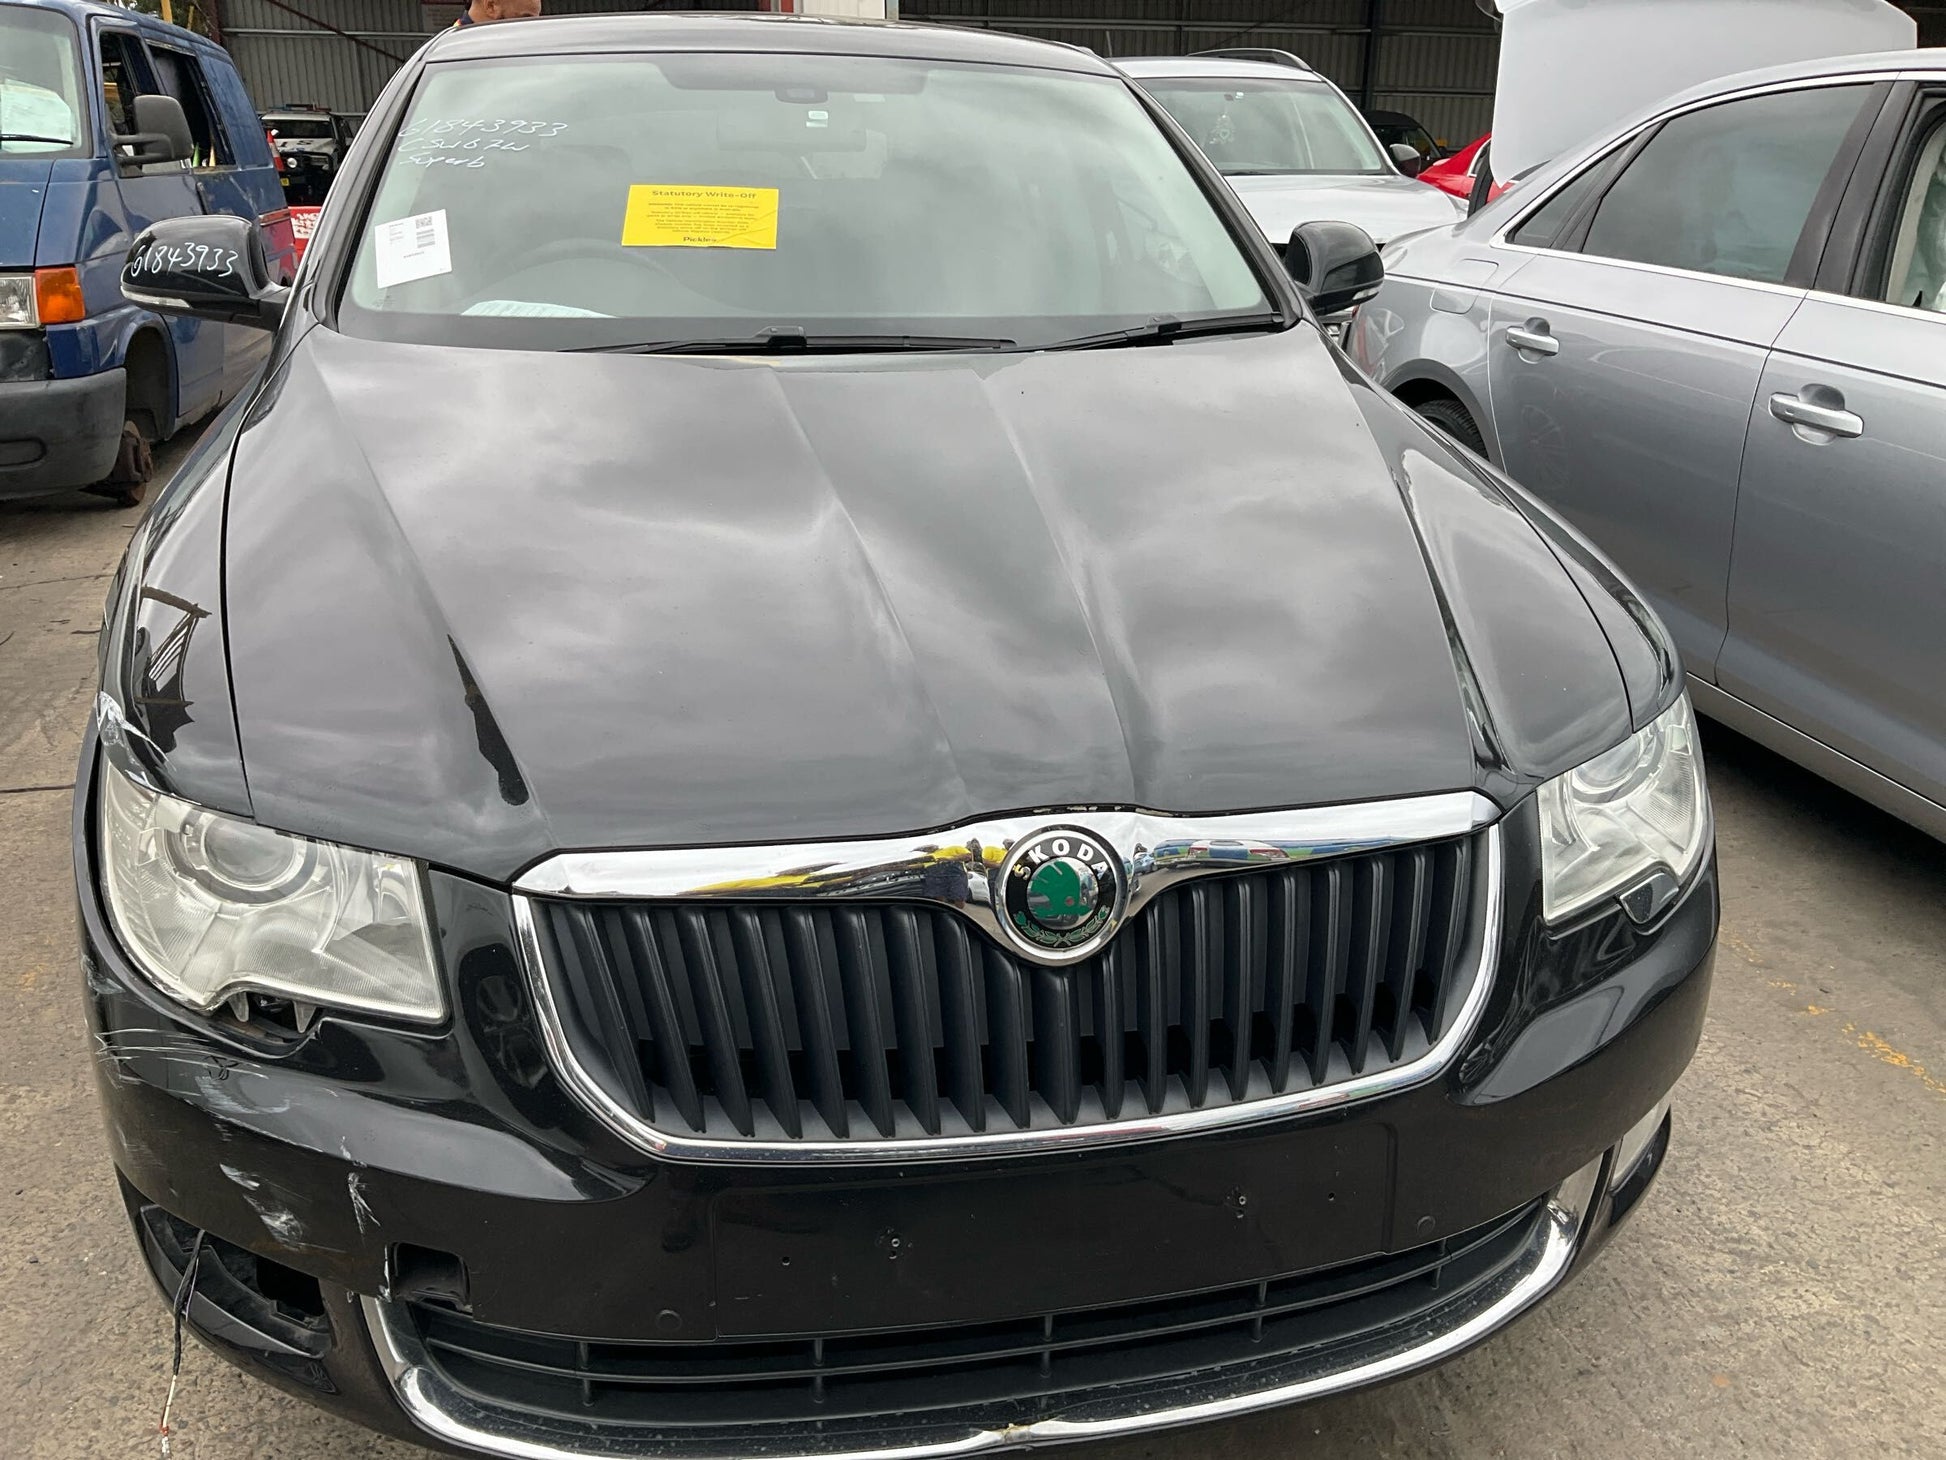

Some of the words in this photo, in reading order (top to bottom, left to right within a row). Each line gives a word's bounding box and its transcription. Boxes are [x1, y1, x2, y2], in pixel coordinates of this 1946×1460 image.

[398, 118, 568, 137] 61843933
[652, 190, 703, 198] Statutory
[705, 191, 757, 199] Write-Off
[130, 242, 239, 277] 61843933
